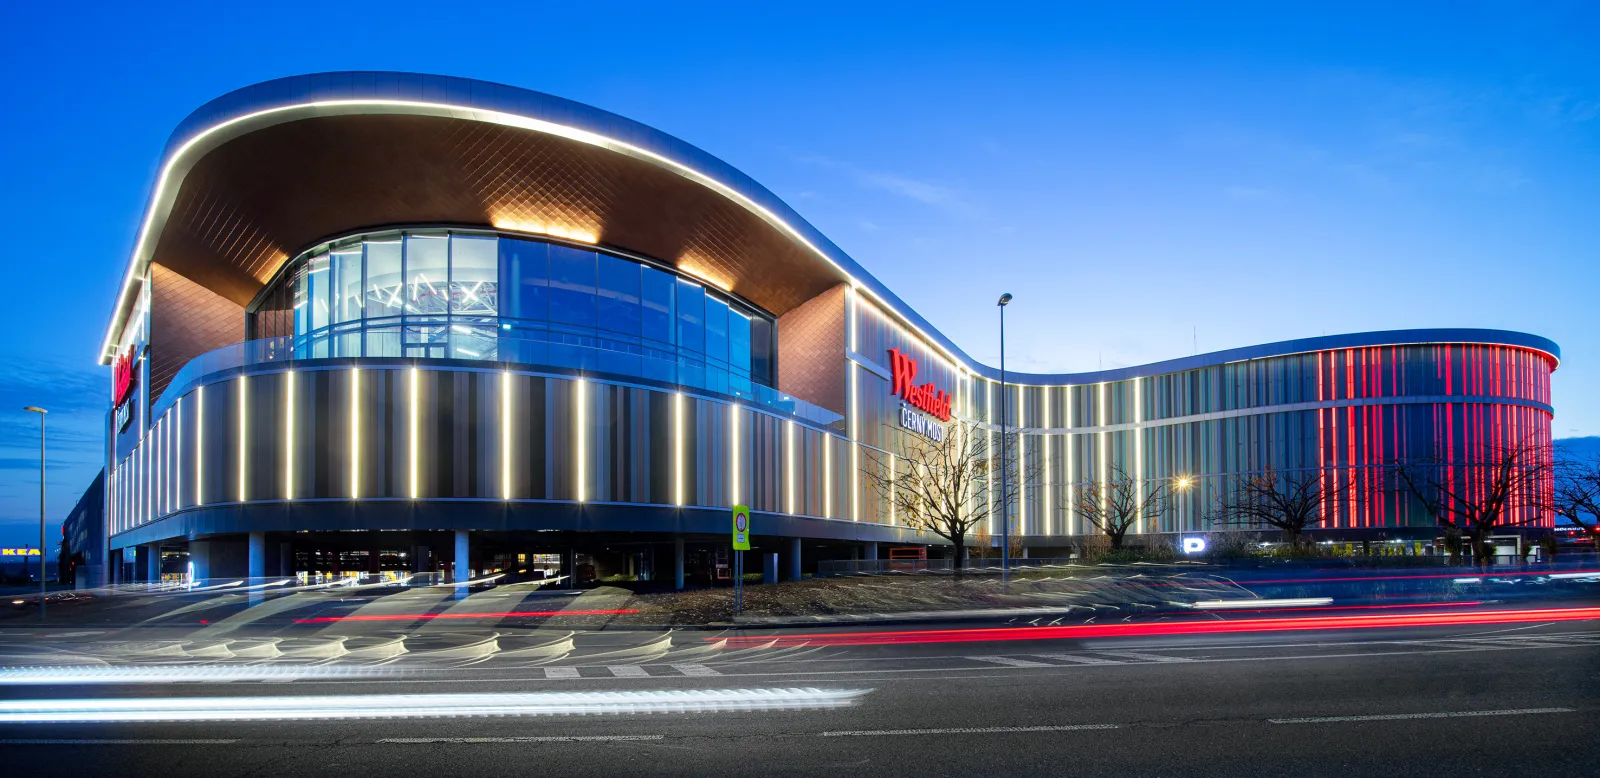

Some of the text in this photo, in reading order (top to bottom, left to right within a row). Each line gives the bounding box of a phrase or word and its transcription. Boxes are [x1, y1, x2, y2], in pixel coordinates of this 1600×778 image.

[889, 348, 952, 422] Westfield
[901, 402, 944, 443] ČERNÝ MOST
[0, 548, 41, 556] KEA
